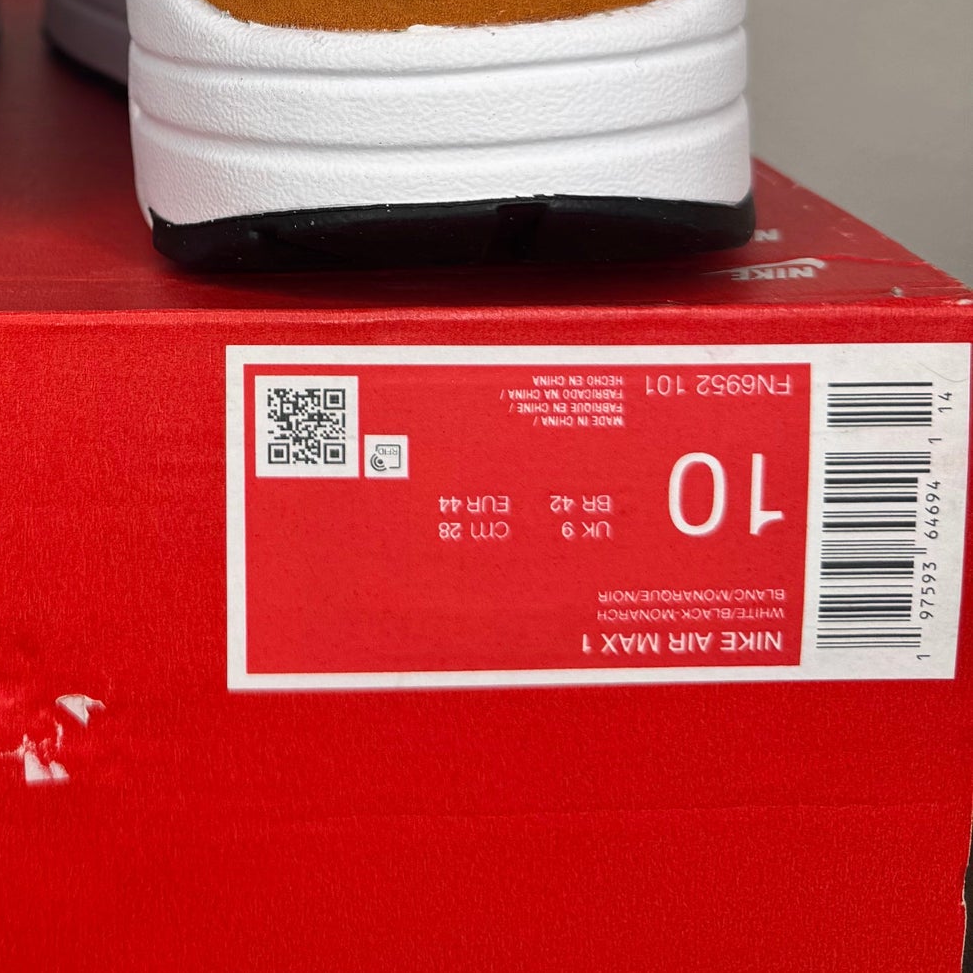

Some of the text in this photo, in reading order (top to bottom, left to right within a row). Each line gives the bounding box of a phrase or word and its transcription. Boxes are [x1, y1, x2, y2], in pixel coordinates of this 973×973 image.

[731, 266, 814, 280] NIKE
[532, 375, 623, 386] HECHO EN CHINA
[645, 374, 792, 396] FN6952 101
[508, 389, 540, 400] CHINA
[544, 389, 560, 400] NA
[562, 389, 623, 400] FABRICADO
[517, 402, 549, 413] CHINE
[552, 402, 567, 413] EN
[570, 402, 623, 414] FABRIQUE
[937, 391, 953, 413] 14
[541, 416, 573, 427] CHINA
[577, 416, 589, 427] IN
[591, 416, 624, 427] MADE
[377, 448, 398, 456] RFID
[668, 451, 786, 537] 10
[438, 495, 510, 513] EUR 44
[550, 494, 612, 513] BR 42
[924, 481, 941, 540] 64694
[438, 521, 461, 540] 28
[561, 521, 612, 539] UK 9
[597, 588, 785, 603] BLANC/MONARQUE/NOIR
[919, 562, 937, 620] 97593
[581, 631, 782, 654] NIKE AIR MAX 1
